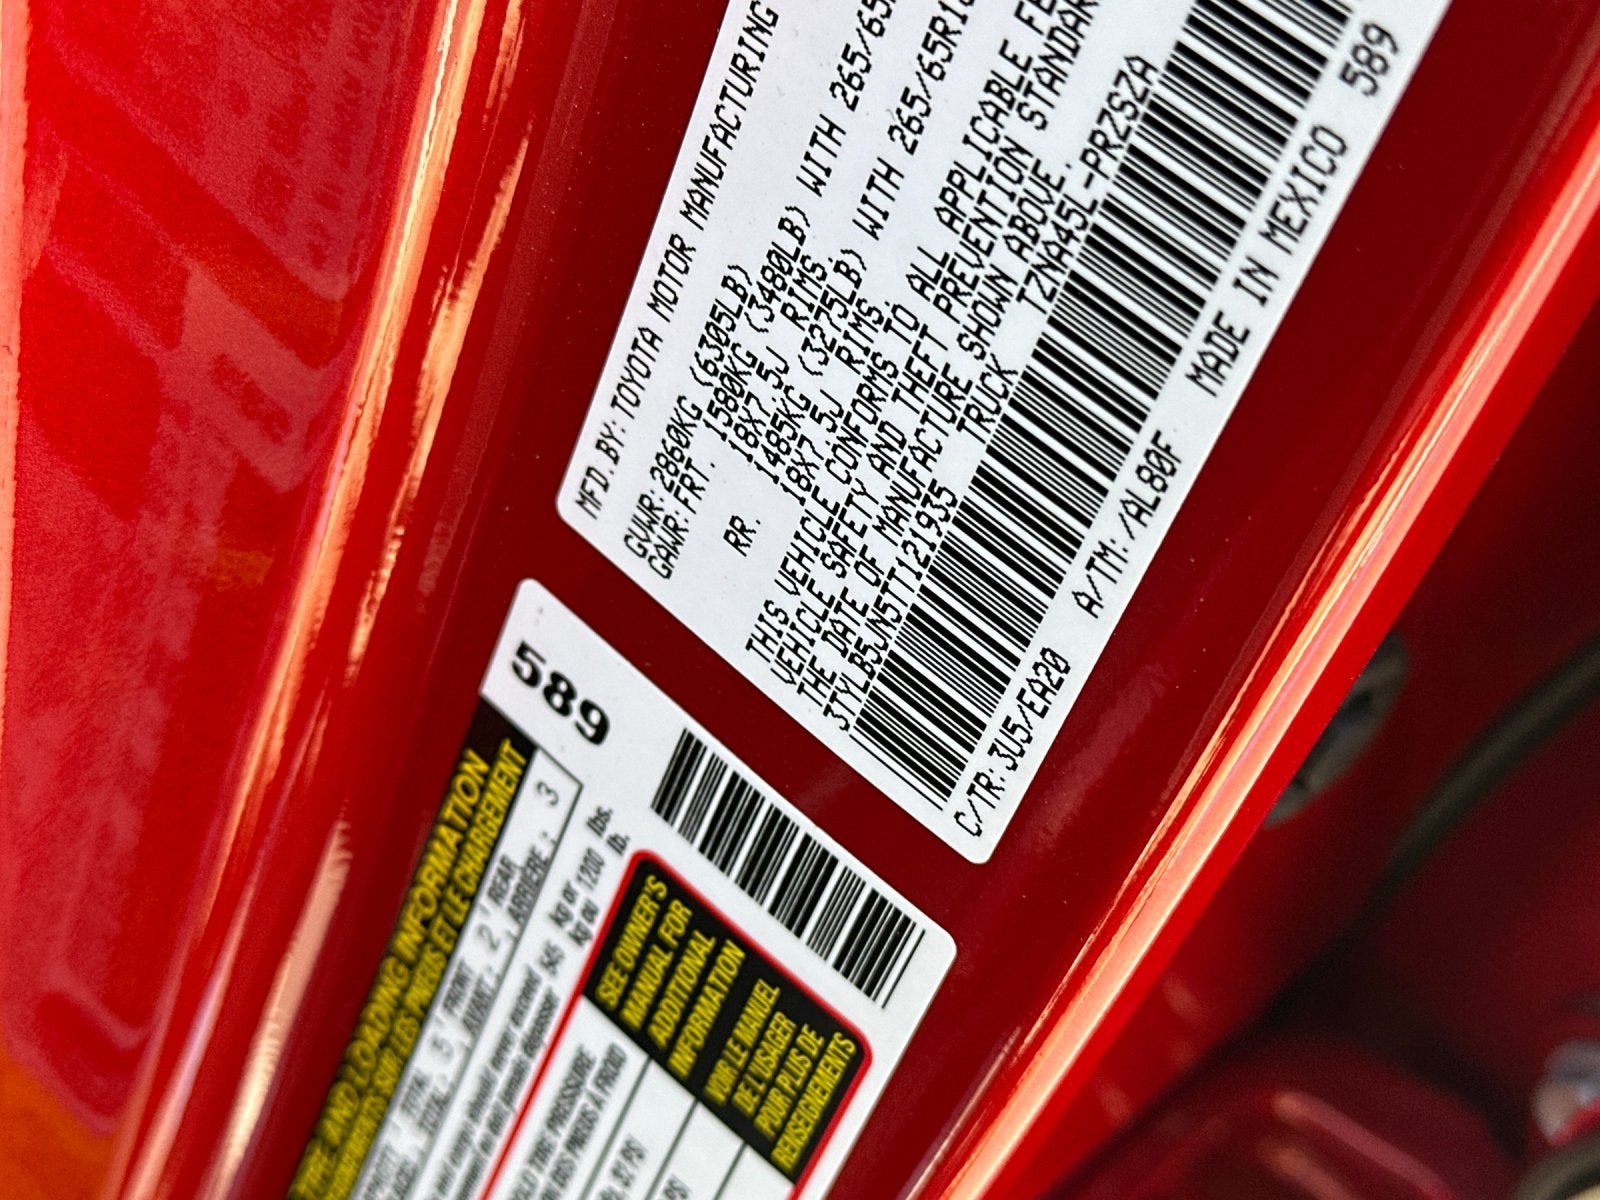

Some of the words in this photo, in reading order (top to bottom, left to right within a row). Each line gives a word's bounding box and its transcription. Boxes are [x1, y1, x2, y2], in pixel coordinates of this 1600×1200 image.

[647, 234, 696, 322] MOTOR
[681, 1, 777, 229] MANUFACTURING
[703, 343, 757, 441] 1580KG
[745, 207, 809, 332] (3480LB)
[796, 114, 845, 197] WITH
[830, 0, 895, 111] 265/65
[1186, 311, 1250, 395] MADE
[1233, 256, 1278, 306] IN
[1260, 126, 1346, 253] MEXICO
[1340, 23, 1398, 96] 589
[690, 265, 751, 389] (6305LB)
[723, 516, 760, 556] RR.
[754, 385, 811, 483] 1485KG
[799, 249, 865, 375] (3275LB)
[853, 157, 904, 240] WITH
[889, 0, 973, 154] 265/65R1
[729, 347, 789, 462] 18X7.5J
[780, 255, 832, 330] RIMS.
[746, 600, 789, 662] THIS
[775, 486, 839, 595] VEHICLE
[826, 352, 898, 484] CONFORMS
[883, 304, 920, 344] TO
[906, 247, 949, 301] ALL
[935, 40, 1032, 233] APPLICABLE
[781, 390, 844, 505] 18X7.5J
[835, 298, 889, 374] RIMS.
[824, 480, 956, 730] 3TYLB5JN5TT121935
[956, 354, 1017, 443] TRUCK
[1017, 57, 1156, 312] TZNA45L-PRZSZA
[771, 579, 834, 684] VEHICLE
[820, 478, 878, 578] SAFETY
[866, 421, 906, 479] AND
[892, 324, 947, 413] THEFT
[934, 137, 1031, 322] PREVENTION
[797, 655, 836, 706] THE
[821, 587, 869, 657] DATE
[854, 544, 884, 587] OF
[874, 364, 972, 545] MANUFACTURE
[957, 264, 1017, 360] SHOWN
[1003, 160, 1070, 262] ABOVE.
[512, 642, 609, 744] 589
[454, 741, 524, 892] CHARGEMENT
[536, 781, 559, 806] 3
[586, 807, 612, 838] lbs.
[350, 958, 408, 1086] LOADING
[396, 752, 495, 958] INFORMATION
[443, 886, 469, 923] LE
[487, 856, 520, 905] REAR
[548, 902, 573, 928] kg
[562, 881, 577, 905] or
[568, 915, 593, 947] kg
[581, 899, 598, 924] ou
[606, 834, 629, 856] lb.
[576, 848, 604, 890] 1200
[476, 924, 500, 952] 2
[598, 963, 627, 1006] SEE
[616, 876, 666, 968] OWNER'S
[623, 946, 672, 1026] MANUAL
[659, 900, 691, 945] FOR
[651, 932, 714, 1044] ADDITIONAL
[671, 941, 743, 1074] INFORMATION
[725, 1038, 748, 1067] LE
[734, 980, 779, 1046] MANUEL
[746, 1012, 794, 1091] L'USAGER
[707, 1060, 737, 1101] VOIR
[734, 1083, 759, 1113] DE
[756, 1088, 790, 1135] POUR
[776, 1048, 811, 1094] PLUS
[797, 1025, 823, 1056] DE
[774, 1034, 854, 1167] RENSEIGNEMENTS
